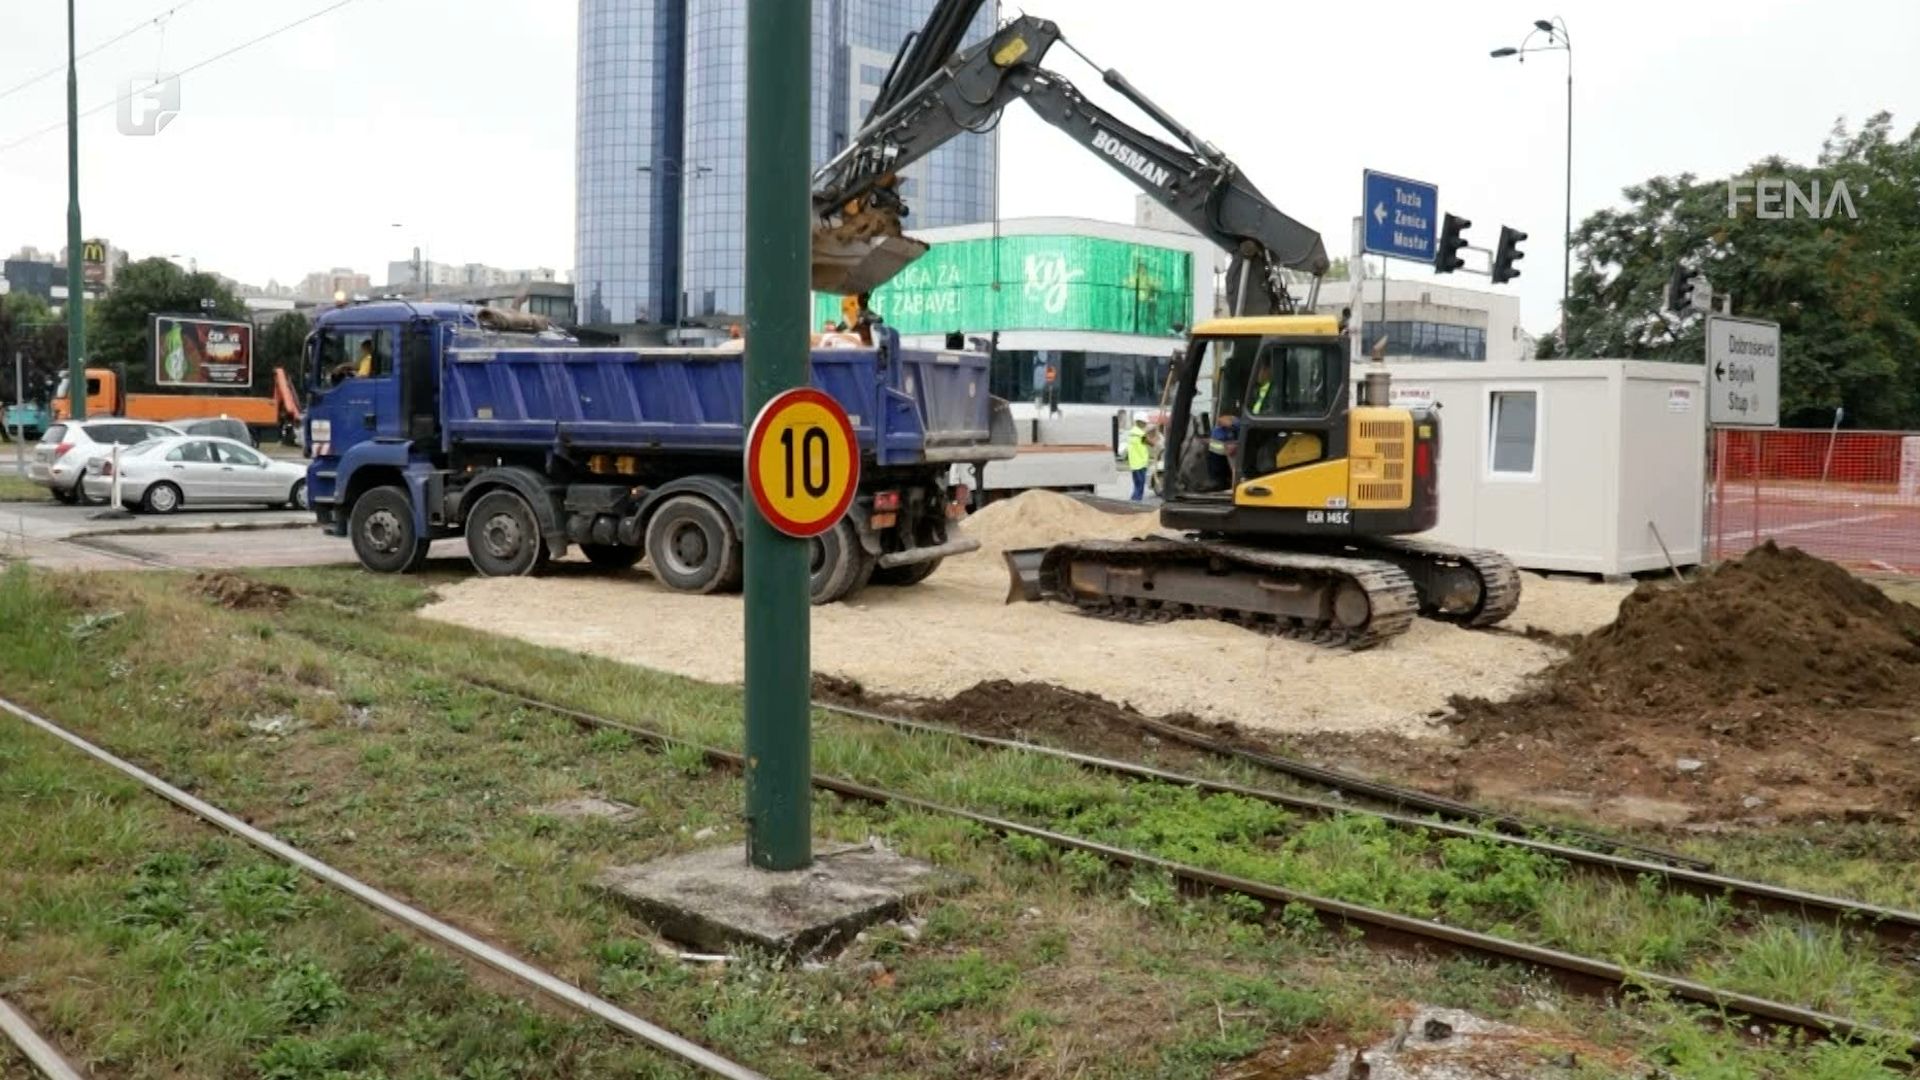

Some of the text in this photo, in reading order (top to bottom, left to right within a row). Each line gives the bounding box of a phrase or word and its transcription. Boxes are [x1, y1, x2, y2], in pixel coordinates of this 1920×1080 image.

[1091, 129, 1170, 187] BOSMAN
[1395, 187, 1422, 208] Tuzla
[1394, 209, 1428, 229] Zenica
[1393, 231, 1429, 250] Mostar
[780, 426, 830, 499] 10
